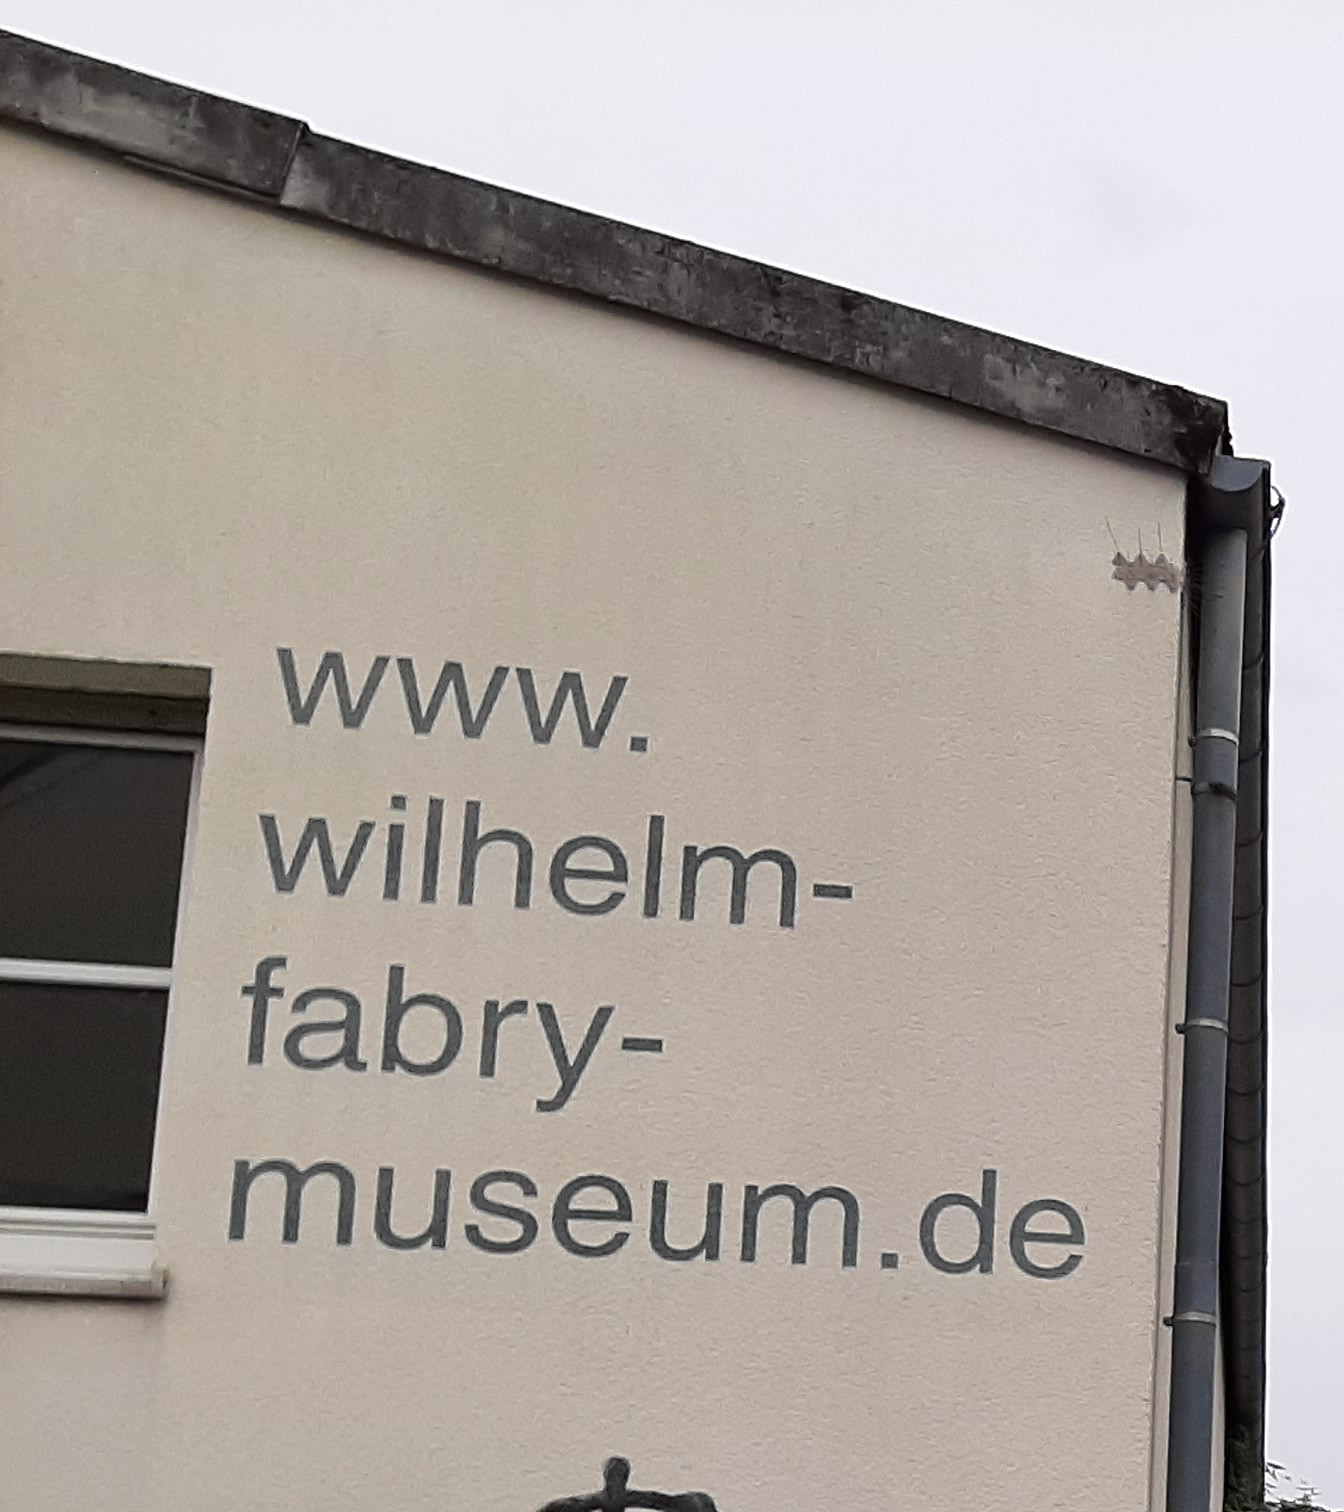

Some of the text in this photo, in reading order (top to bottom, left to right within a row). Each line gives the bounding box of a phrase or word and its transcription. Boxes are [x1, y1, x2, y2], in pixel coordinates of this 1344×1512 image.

[276, 647, 648, 753] www.
[259, 795, 853, 929] wilhelm-
[241, 957, 663, 1113] fabry-
[228, 1159, 1085, 1280] museum.de
